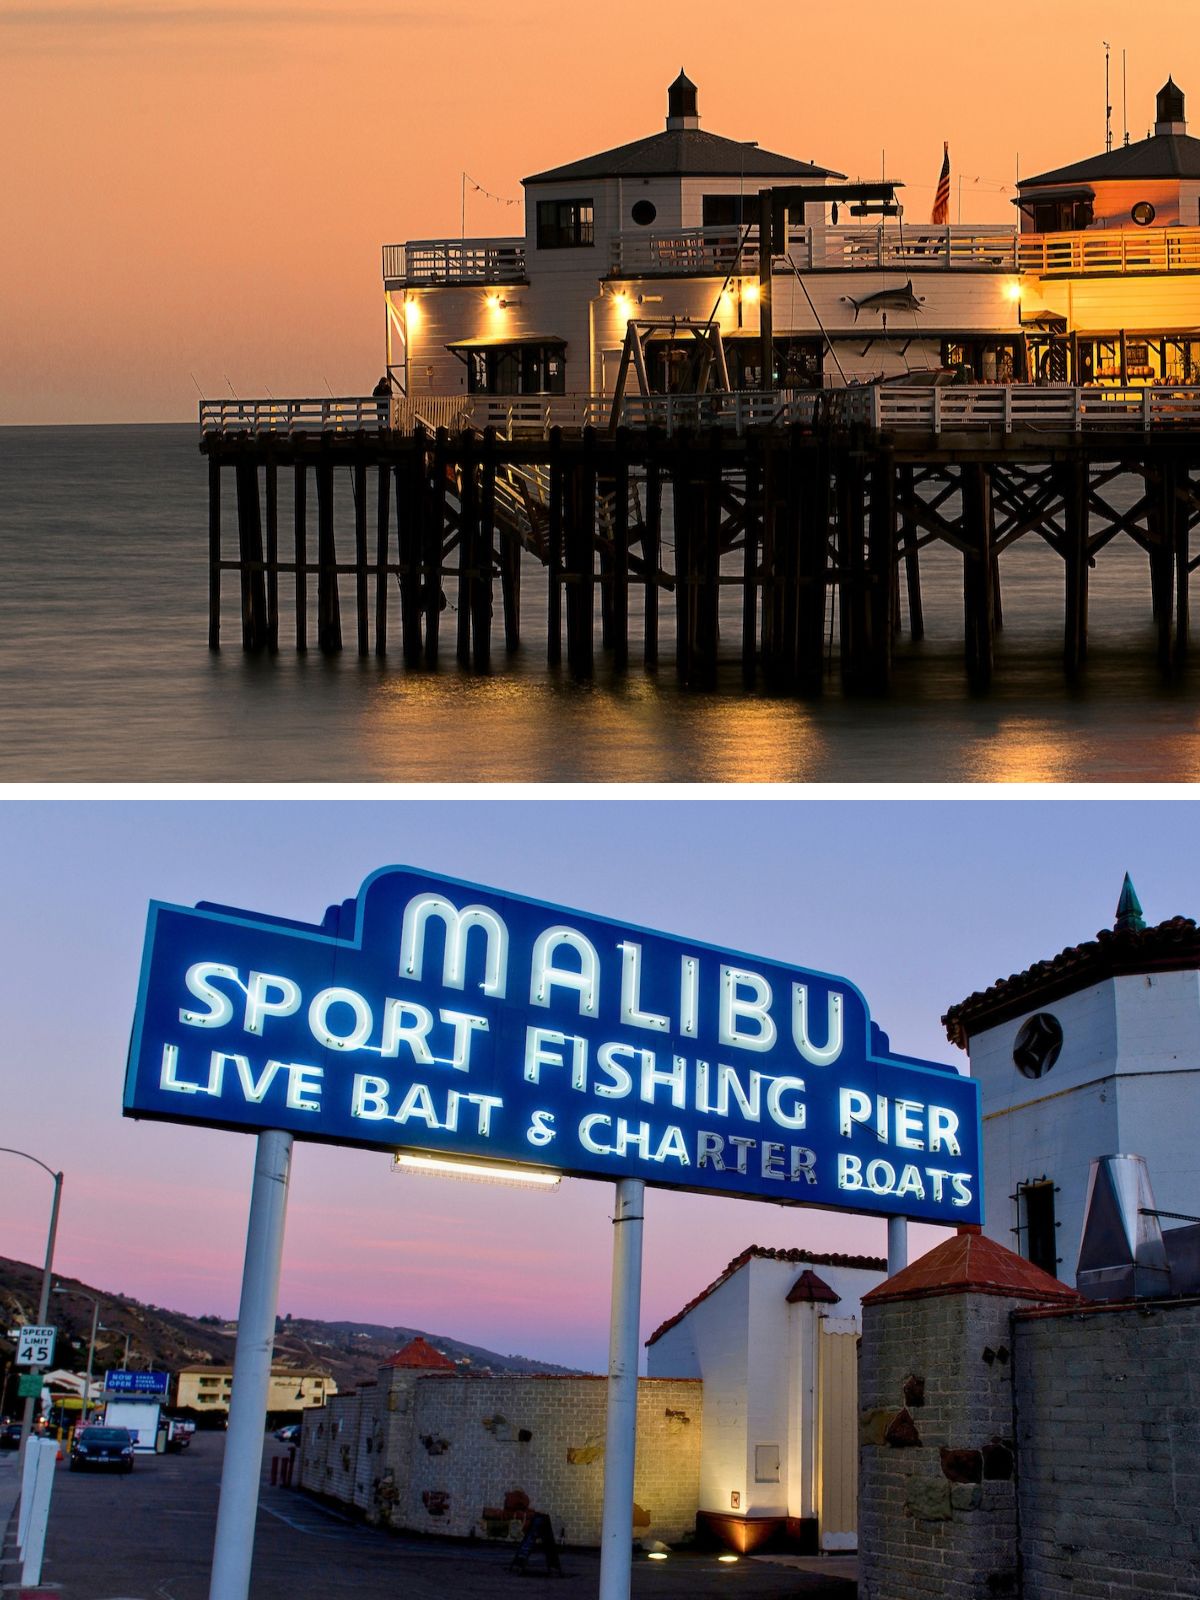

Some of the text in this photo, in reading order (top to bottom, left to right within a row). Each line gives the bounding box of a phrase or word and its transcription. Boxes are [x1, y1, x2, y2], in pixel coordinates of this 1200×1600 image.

[399, 893, 844, 1067] MALIBU
[179, 961, 962, 1157] SPORT FISHING PIER
[159, 1042, 973, 1208] LIVE BAIT & CHARTER BOATS
[22, 1329, 54, 1337] SPEED
[20, 1346, 49, 1361] 45
[108, 1380, 131, 1388] OPEN
[112, 1373, 132, 1381] NOW
